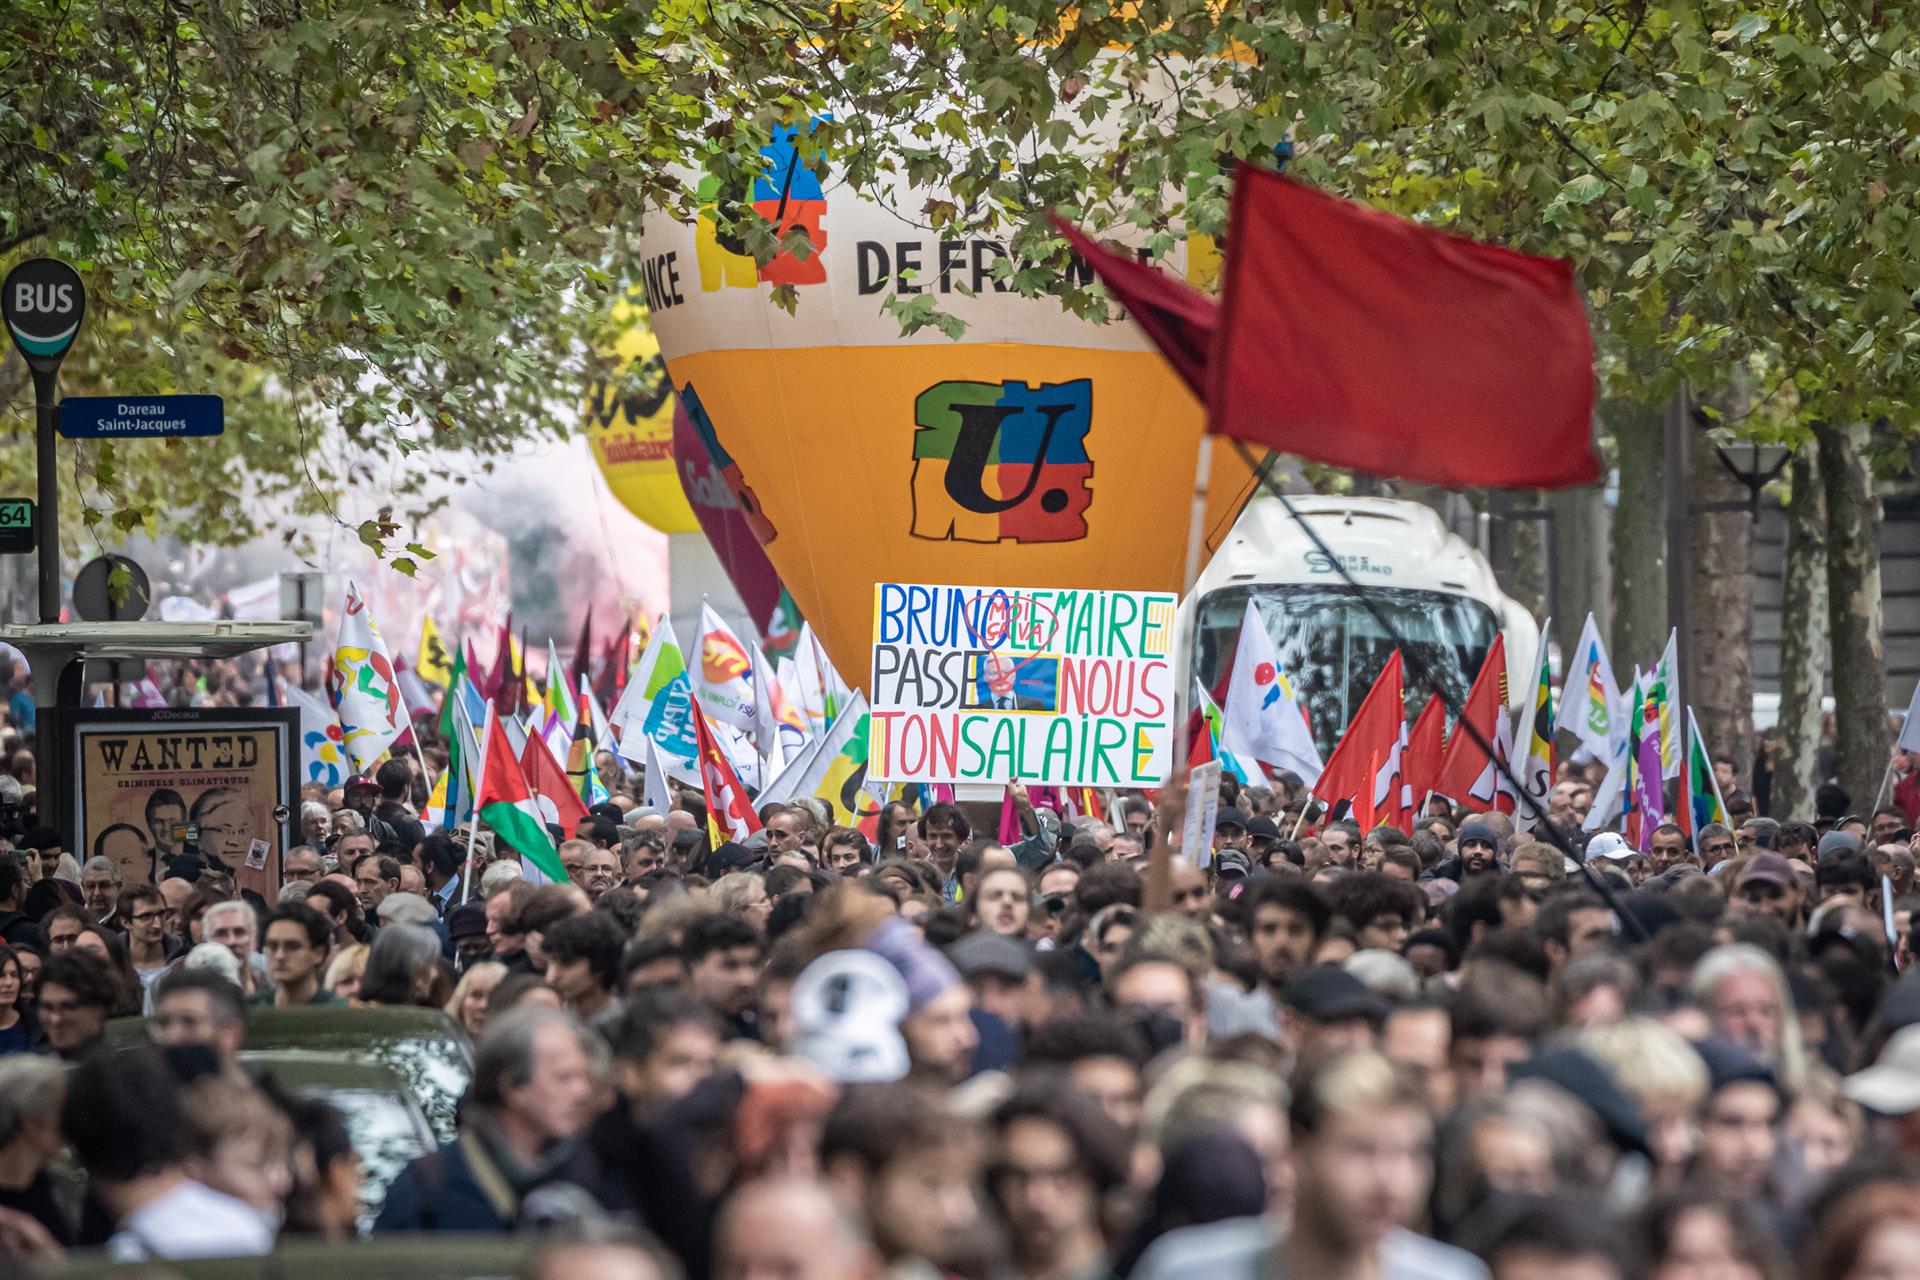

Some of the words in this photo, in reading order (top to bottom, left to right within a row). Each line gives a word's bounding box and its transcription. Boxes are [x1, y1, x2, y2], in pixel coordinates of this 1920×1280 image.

[856, 241, 922, 295] DE
[15, 283, 73, 313] BUS
[97, 419, 186, 432] Saint-Jacques
[118, 404, 165, 416] Dareau
[0, 505, 27, 525] 64
[881, 583, 1010, 650] BRUNO
[875, 644, 990, 710] PASSE
[1060, 657, 1168, 718] NOUS
[152, 710, 200, 720] JCDecaux
[98, 735, 258, 771] WANTED
[872, 711, 959, 778] TON
